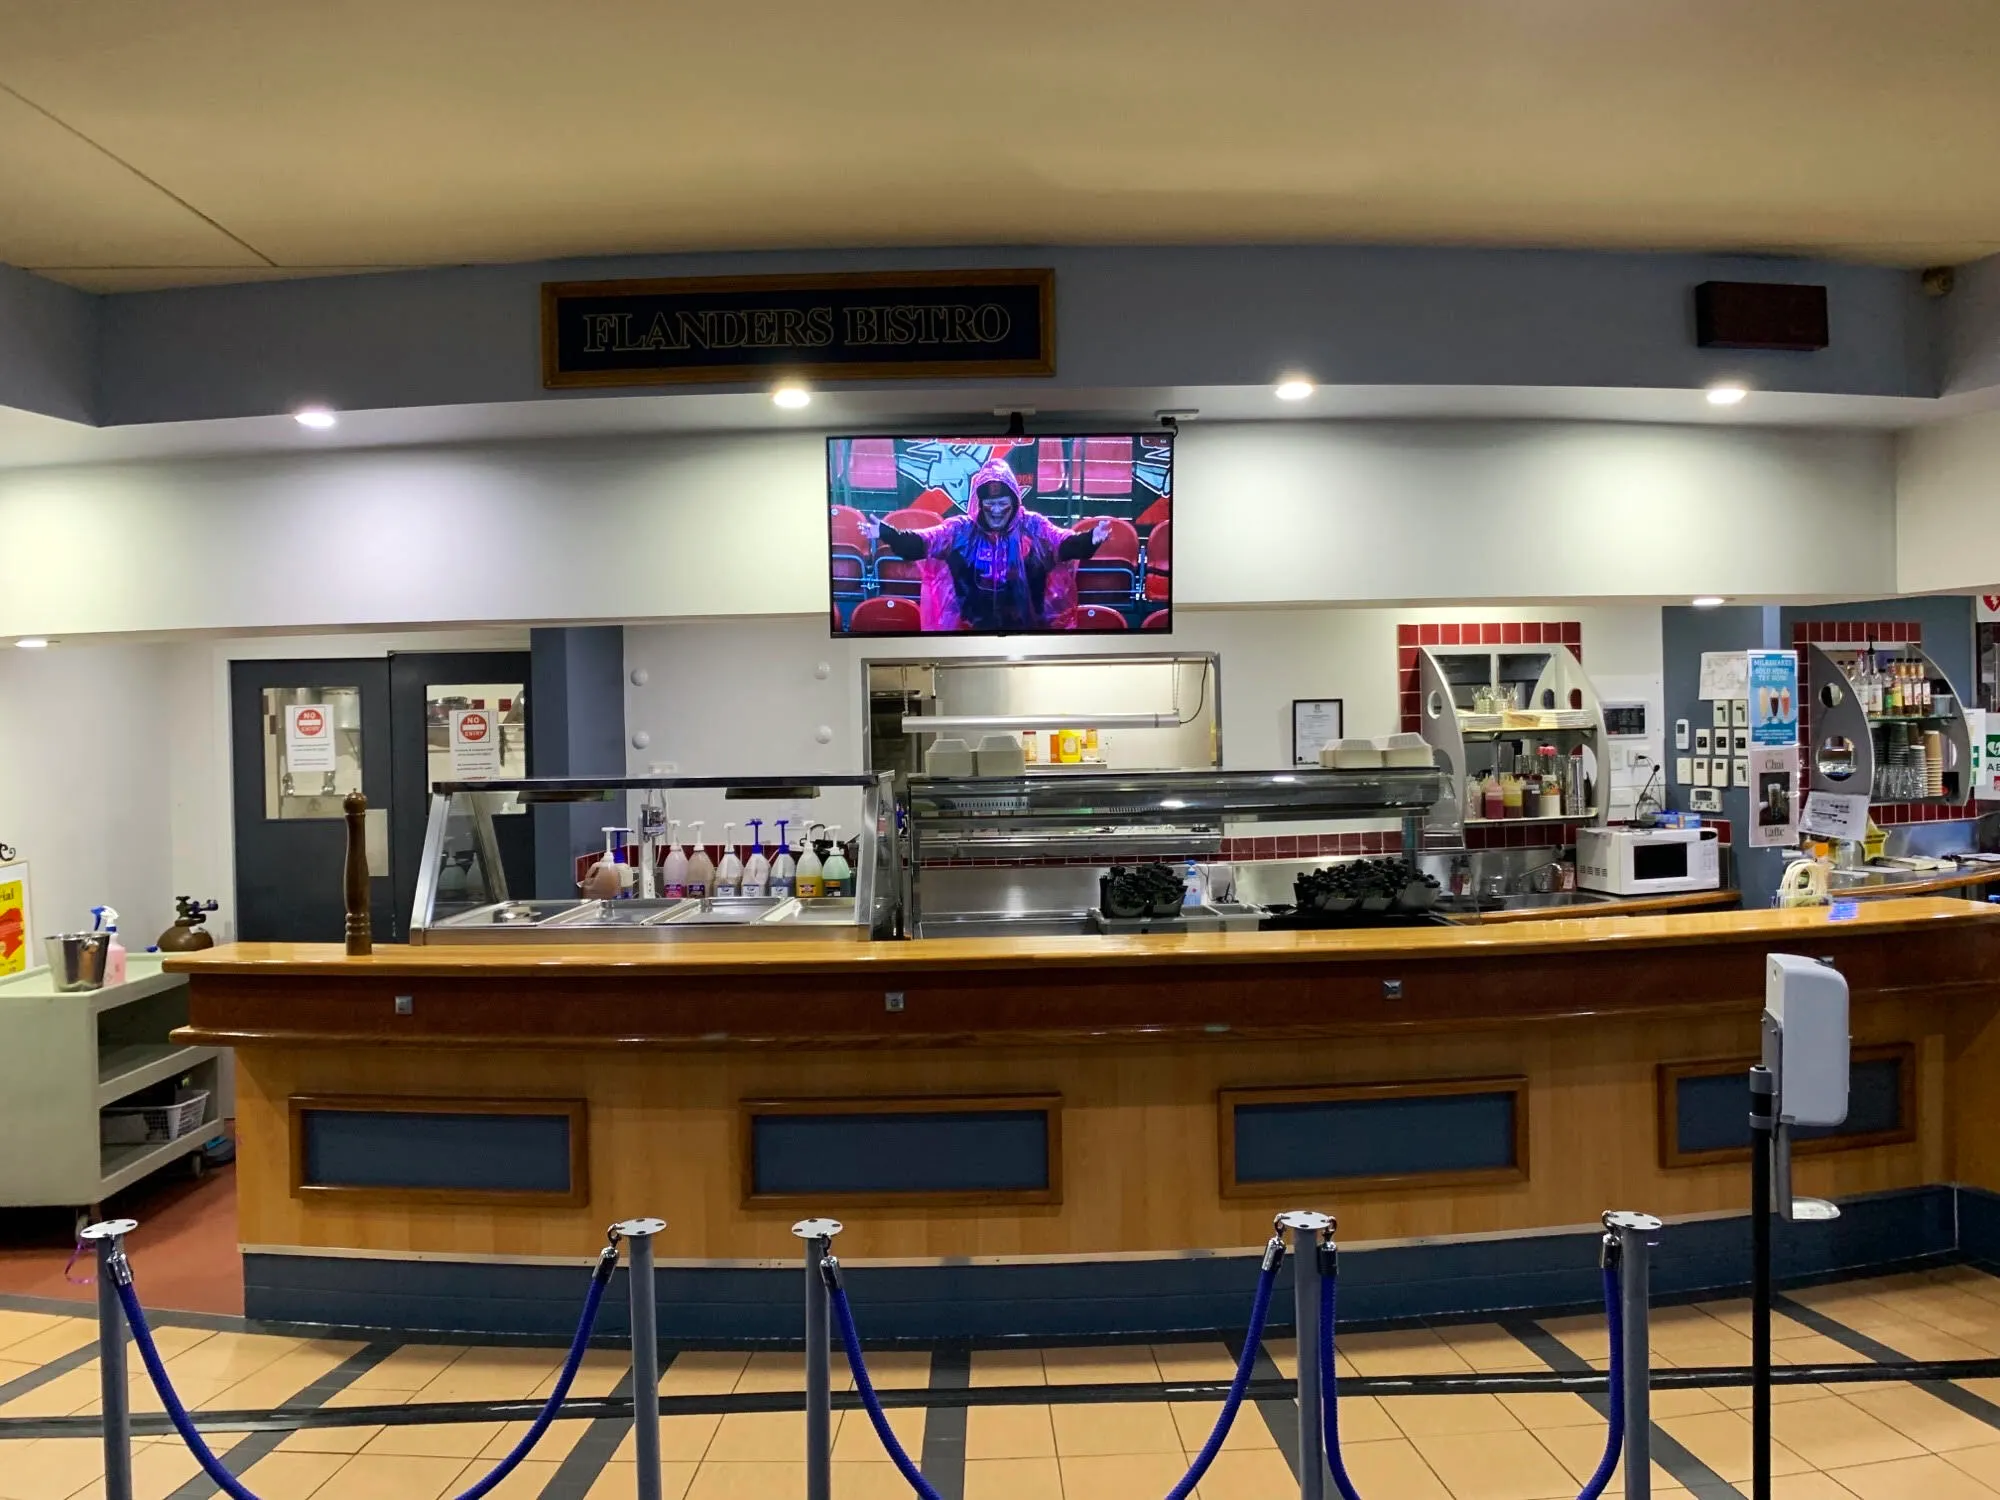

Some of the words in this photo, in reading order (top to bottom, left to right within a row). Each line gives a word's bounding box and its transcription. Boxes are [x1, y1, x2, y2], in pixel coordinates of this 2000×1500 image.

[583, 307, 834, 352] FLANDERS
[844, 304, 1011, 345] BISTRO
[303, 711, 317, 719] NO
